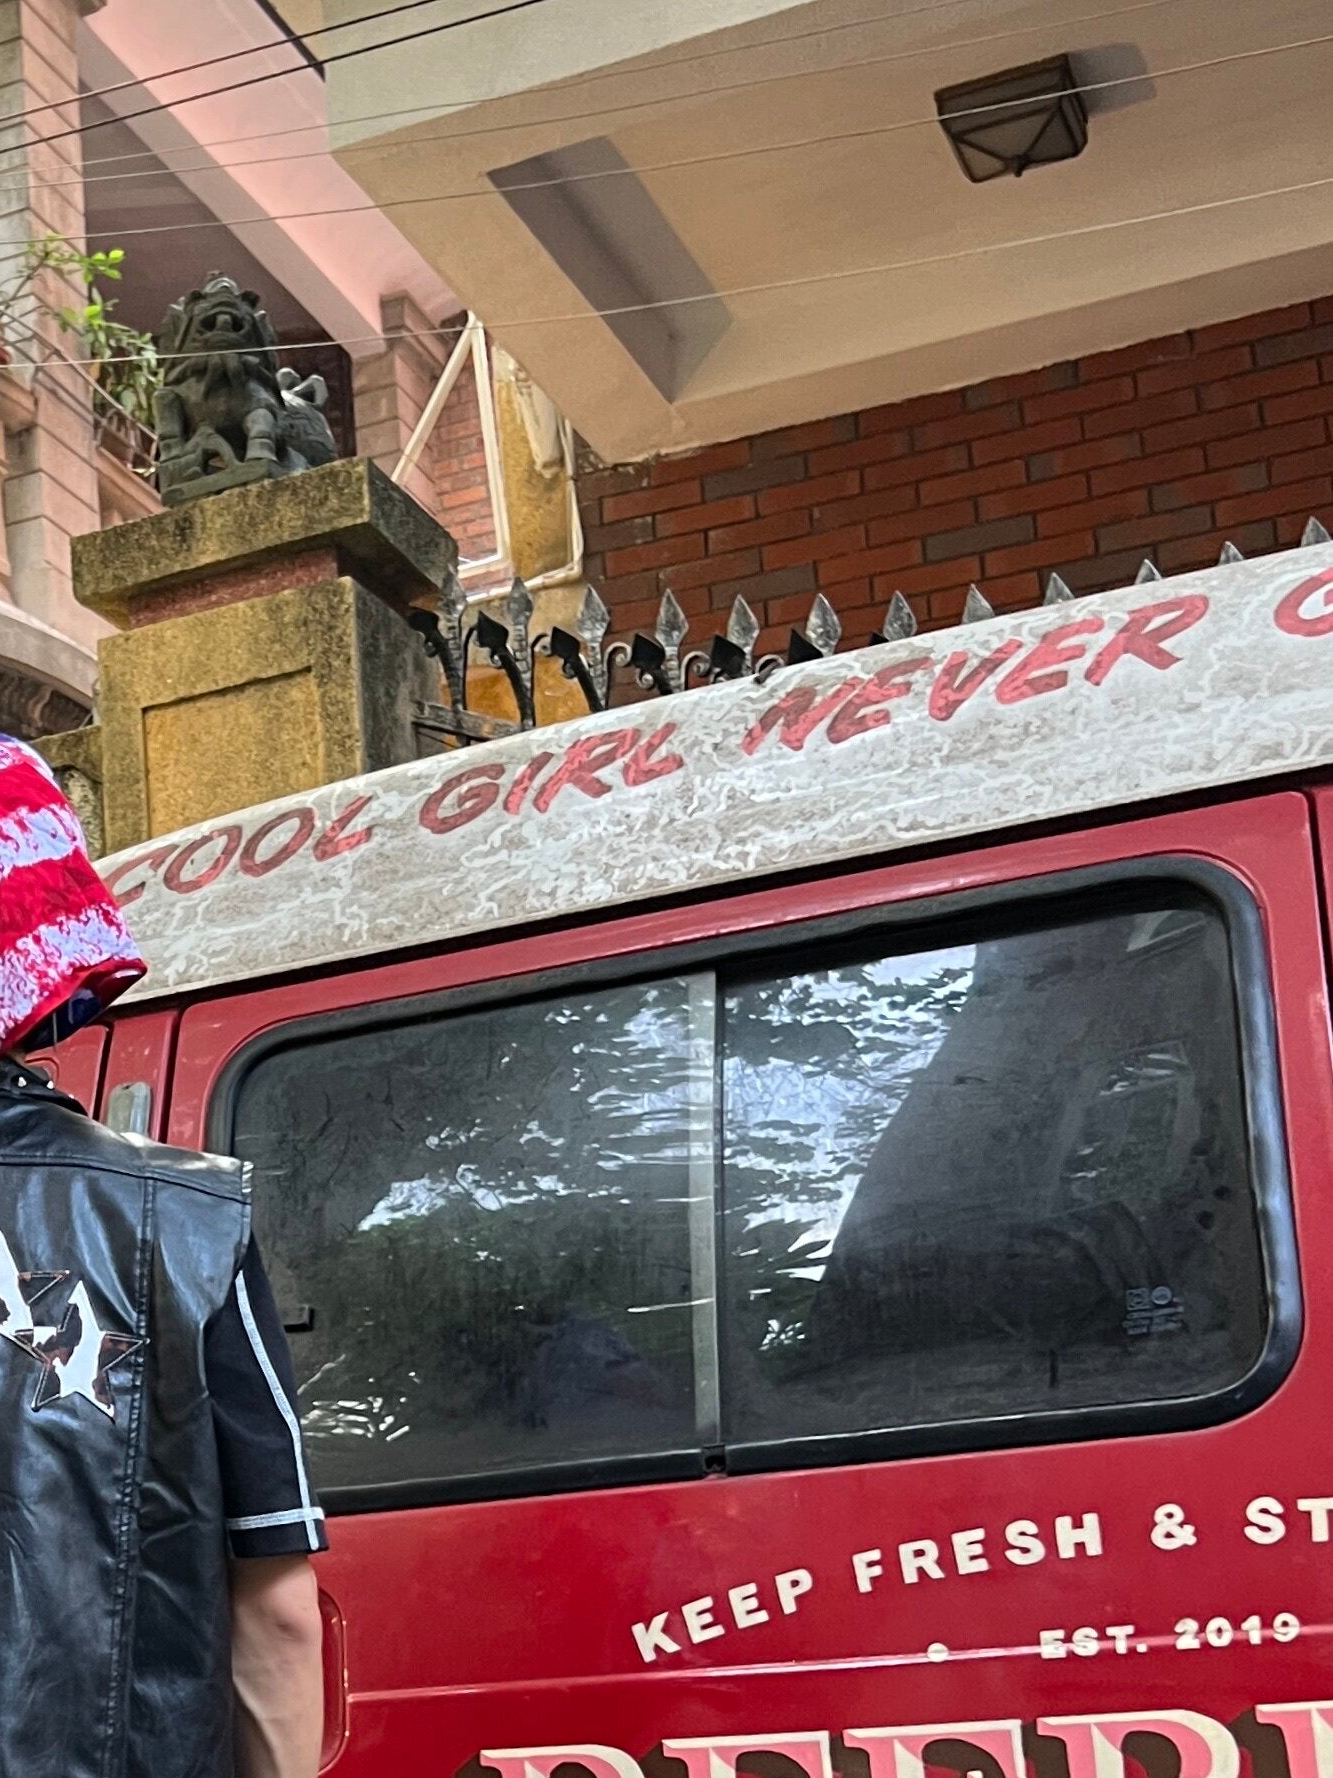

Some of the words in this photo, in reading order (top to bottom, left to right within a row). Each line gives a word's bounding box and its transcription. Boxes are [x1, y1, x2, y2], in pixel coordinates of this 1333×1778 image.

[104, 794, 377, 908] COOL
[419, 721, 685, 835] GIRL
[740, 593, 1210, 756] NEVER
[631, 1567, 813, 1664] KEEP
[852, 1511, 1103, 1594] FRESH
[1150, 1502, 1198, 1551] &
[1039, 1624, 1148, 1659] EST.
[1174, 1611, 1301, 1650] 2019
